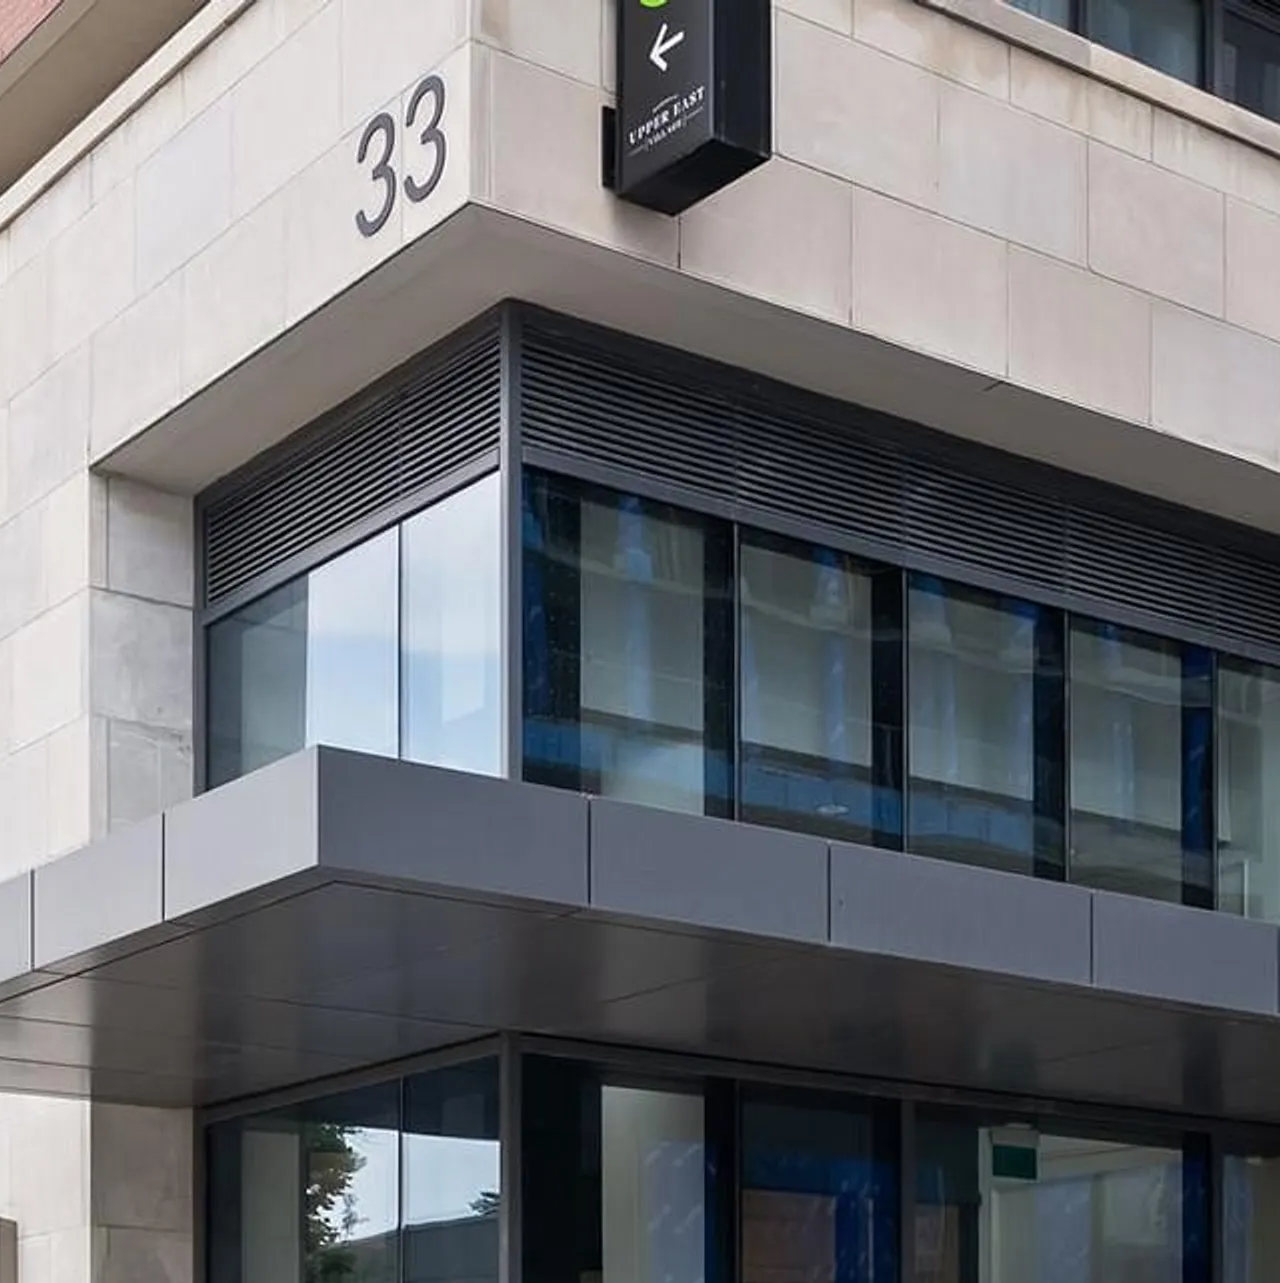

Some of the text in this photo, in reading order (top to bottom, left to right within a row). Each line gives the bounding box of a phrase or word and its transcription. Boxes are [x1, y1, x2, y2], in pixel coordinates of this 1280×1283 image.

[355, 74, 447, 238] 33
[629, 86, 705, 145] UPPER EAST
